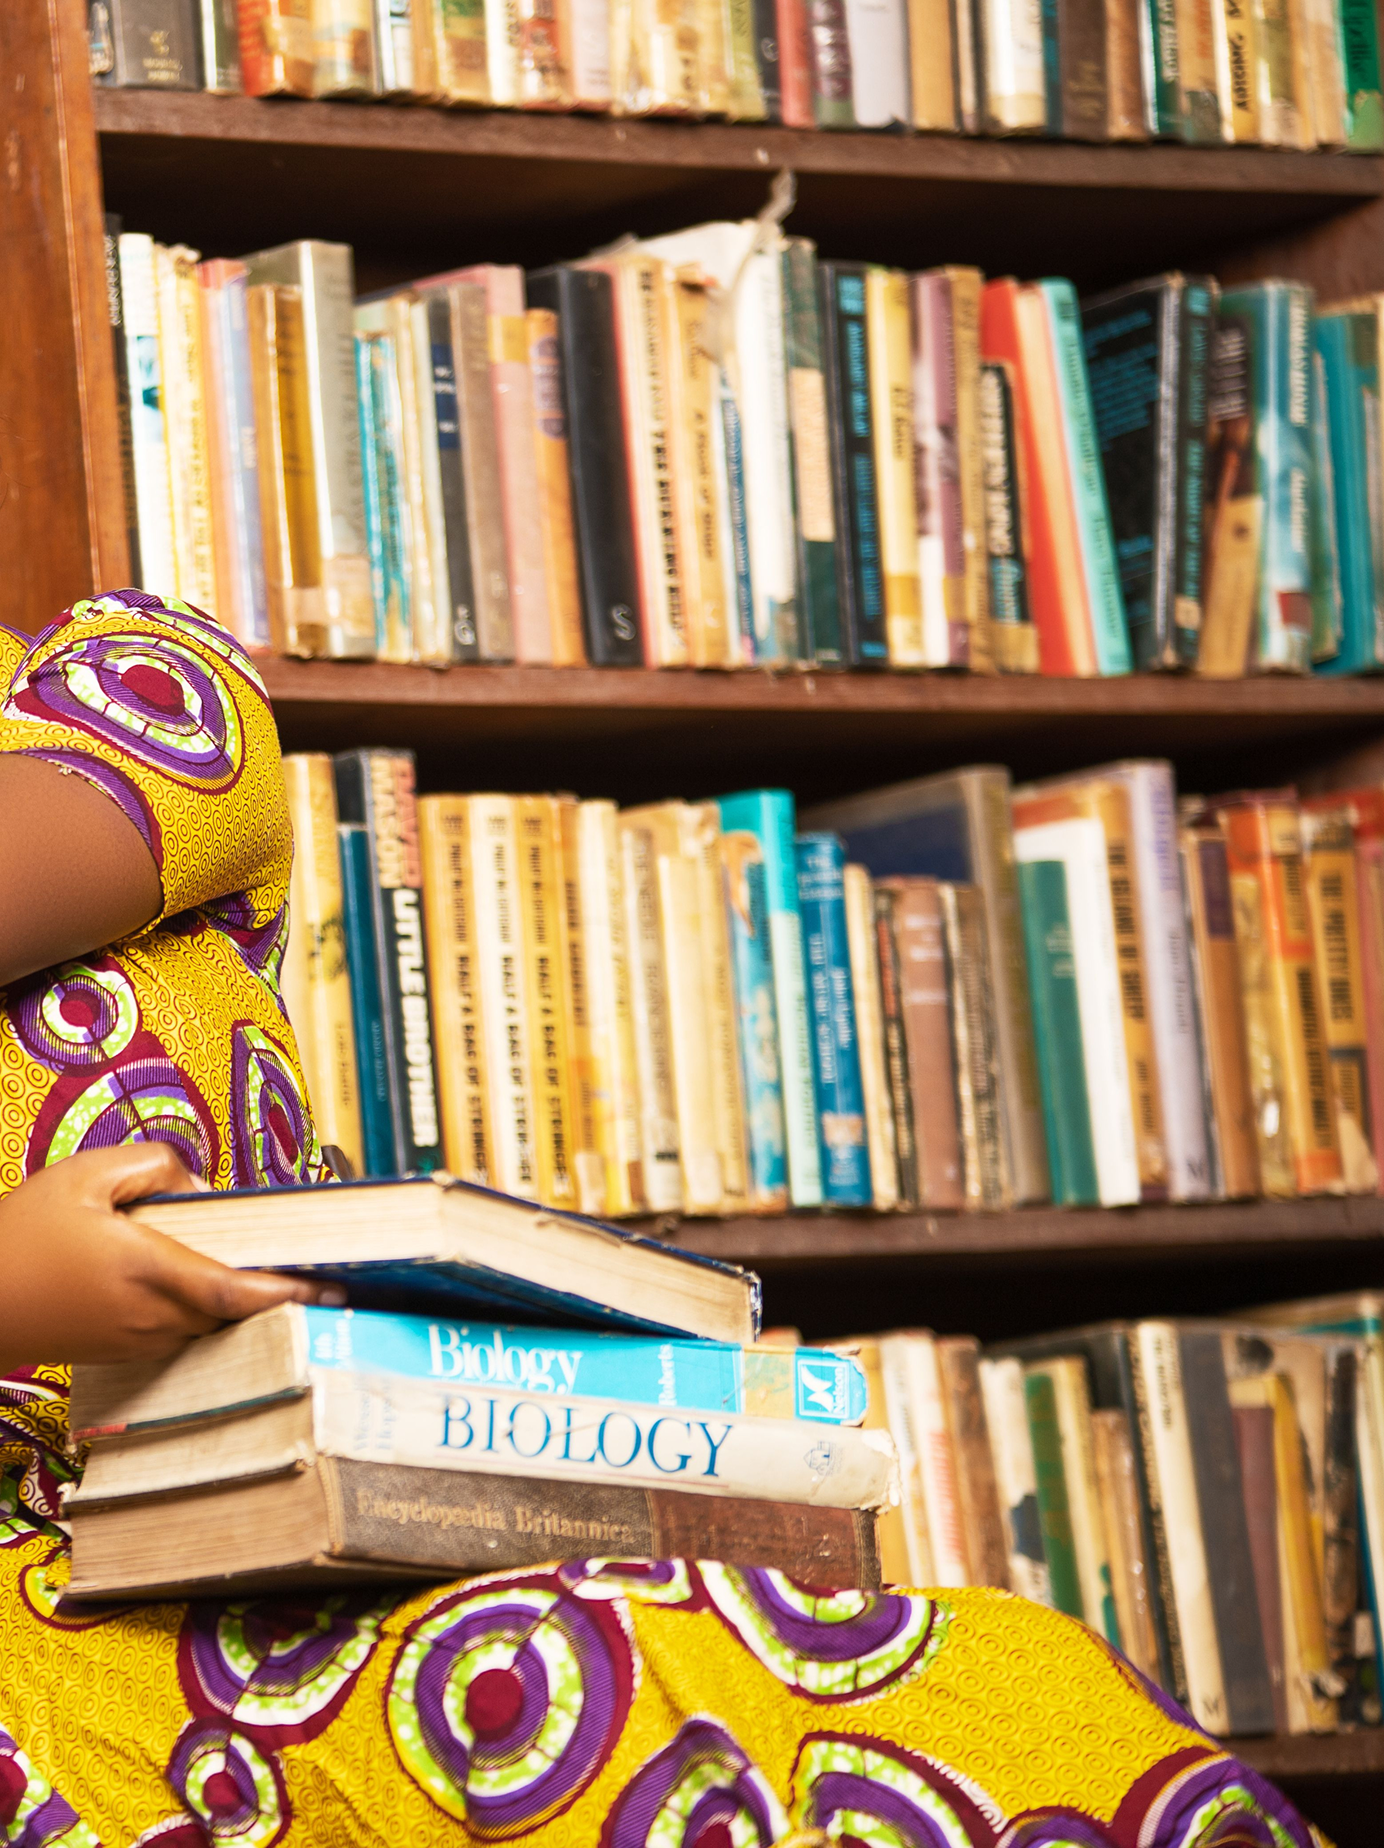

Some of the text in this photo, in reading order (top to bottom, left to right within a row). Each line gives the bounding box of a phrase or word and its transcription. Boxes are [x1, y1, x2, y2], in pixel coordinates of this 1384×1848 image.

[610, 604, 637, 640] S
[371, 758, 402, 888] MASON
[394, 889, 439, 1147] LITTLE BROTHER
[428, 1323, 583, 1395] Biology
[833, 1366, 846, 1414] Nelson
[438, 1394, 733, 1477] BIOLOGY
[516, 1505, 635, 1544] Britannica
